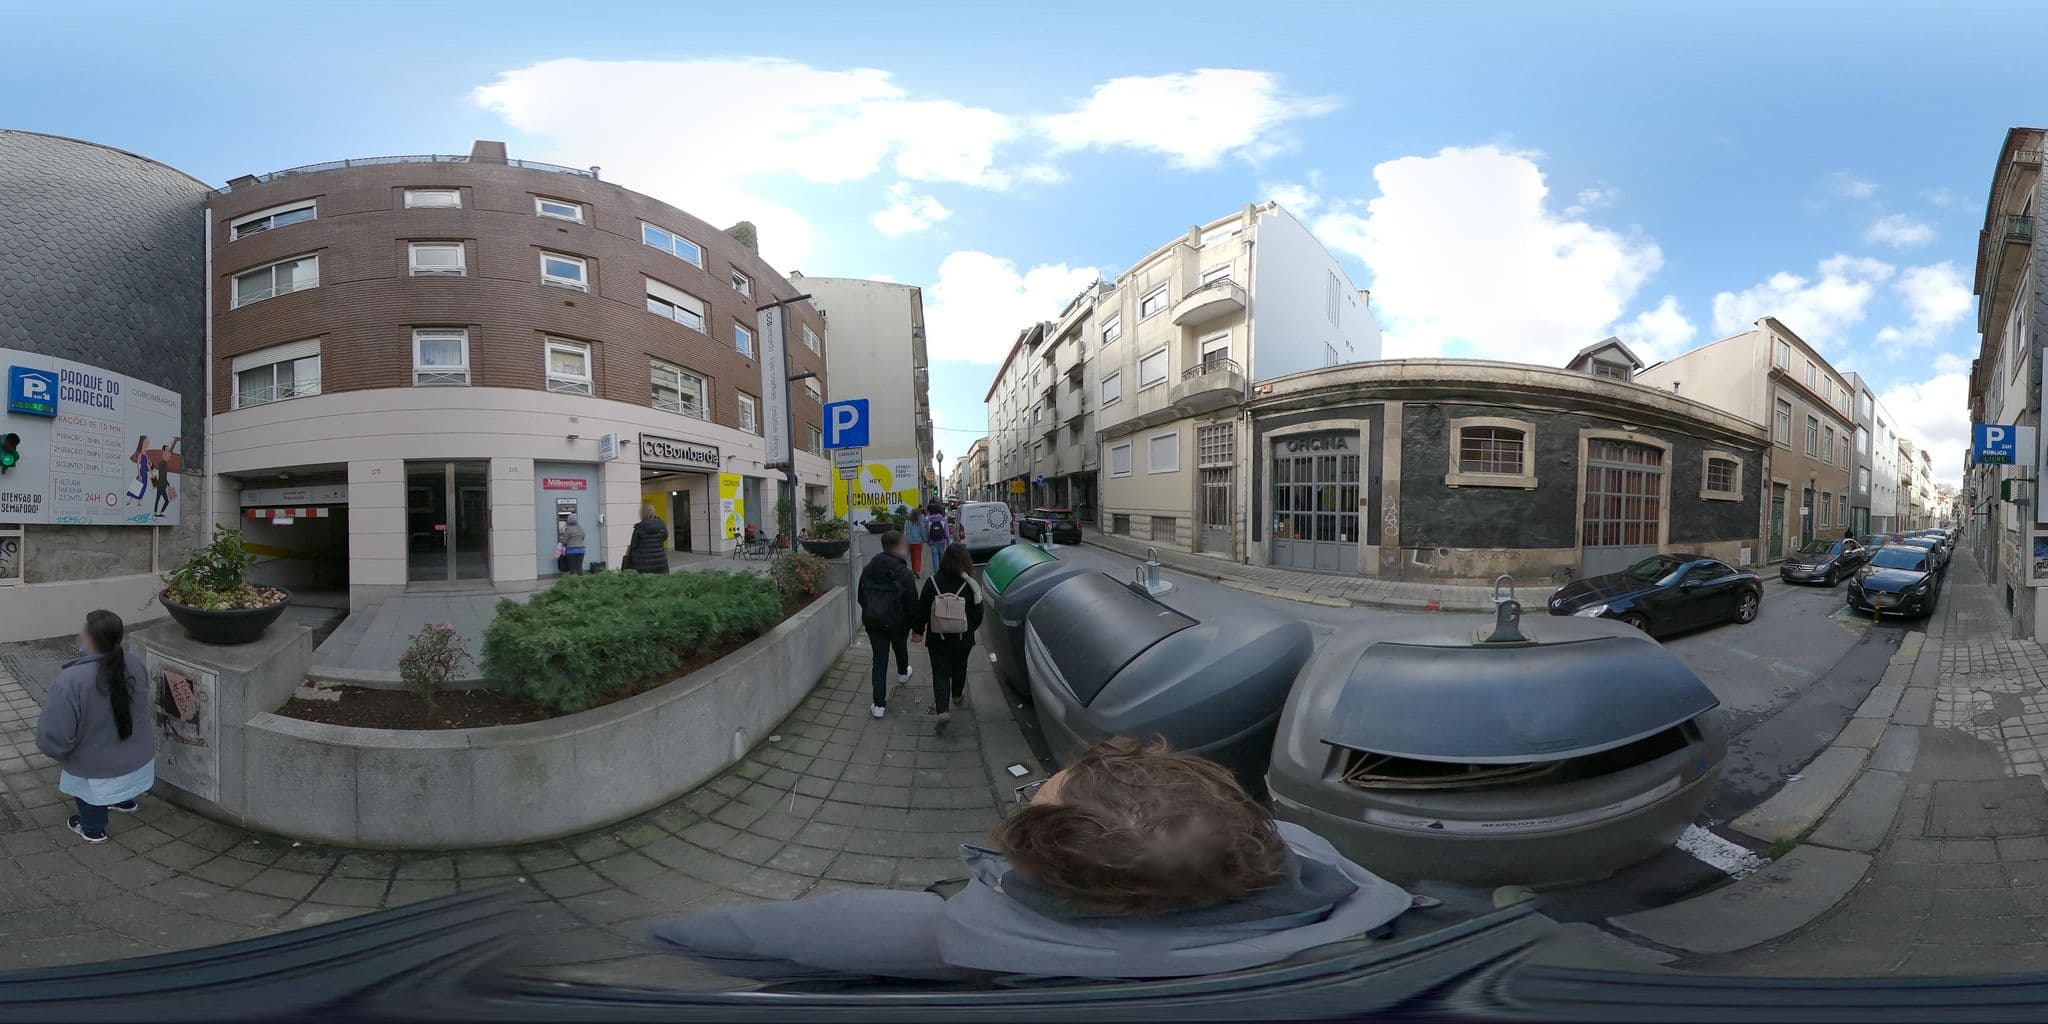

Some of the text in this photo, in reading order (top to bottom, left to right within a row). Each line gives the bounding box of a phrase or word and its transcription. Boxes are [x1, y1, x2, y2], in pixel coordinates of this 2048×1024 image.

[24, 378, 47, 397] P
[61, 369, 120, 395] PARQUE DO
[60, 386, 115, 410] CARREGAL
[832, 404, 859, 445] P
[1987, 427, 2005, 449] P
[642, 440, 719, 464] CCBombarda
